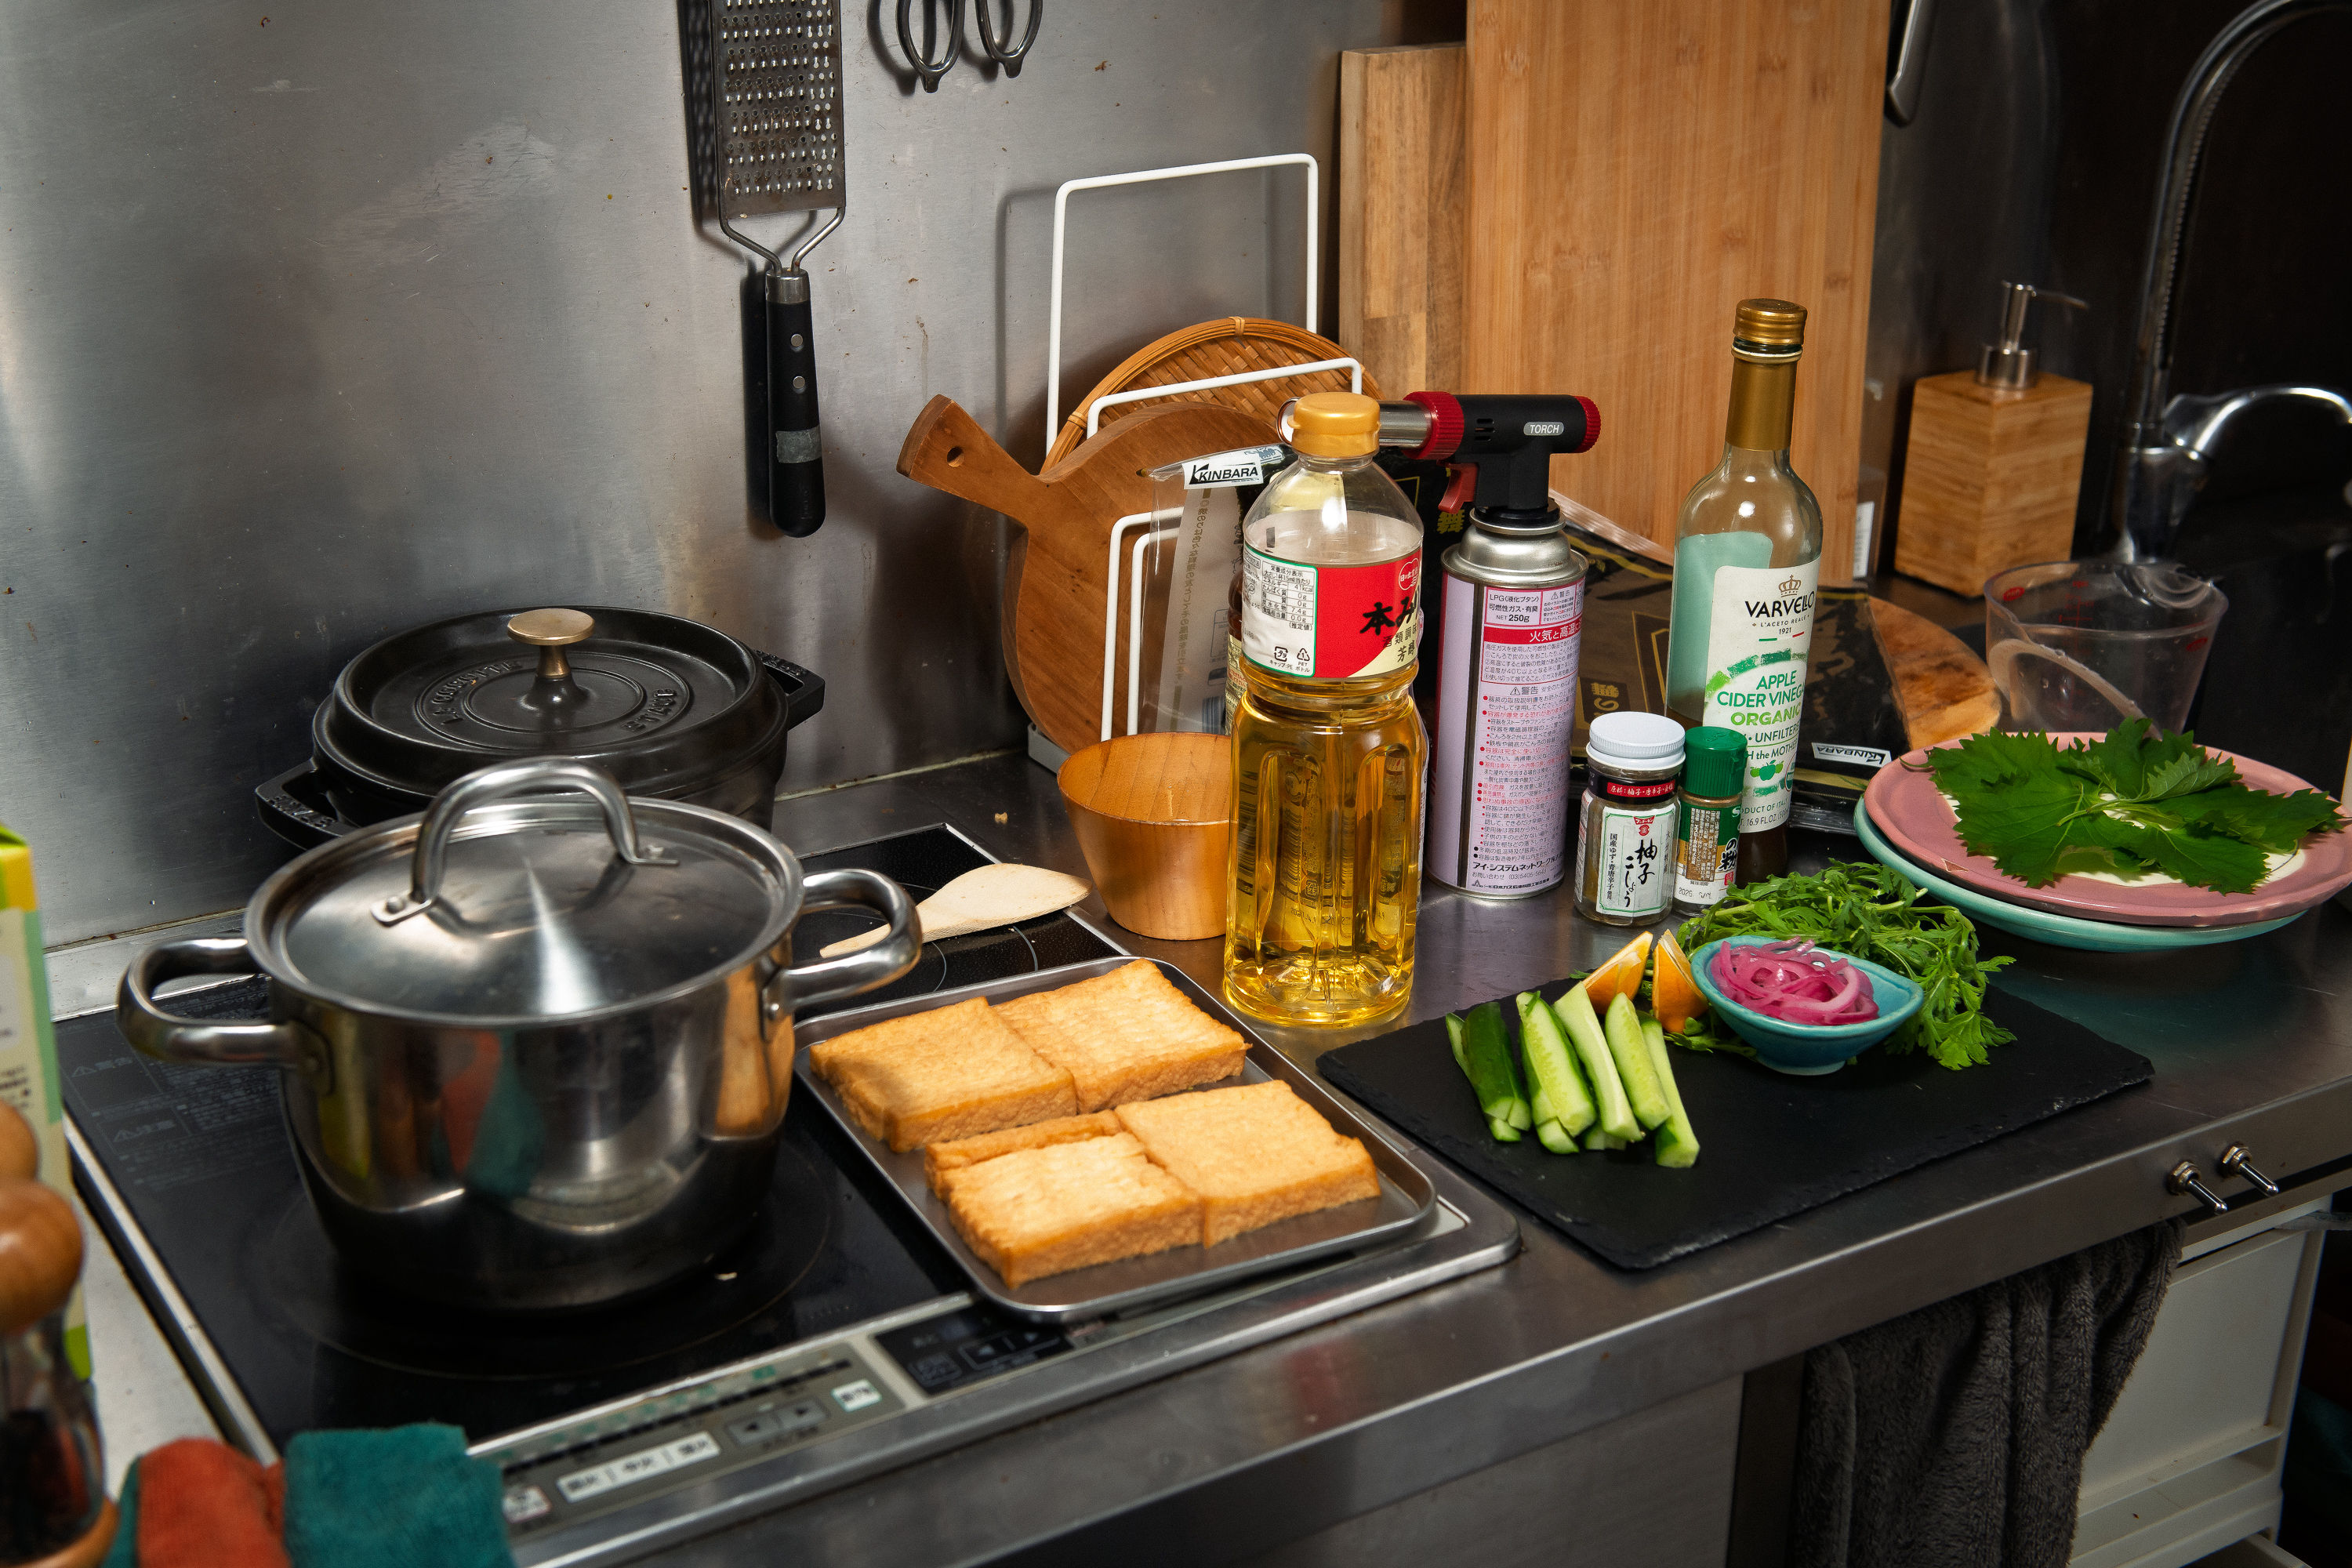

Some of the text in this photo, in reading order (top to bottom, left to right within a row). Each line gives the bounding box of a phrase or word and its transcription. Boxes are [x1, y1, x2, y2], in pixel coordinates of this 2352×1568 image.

[1530, 424, 1559, 434] TORCH
[1199, 466, 1258, 481] KINBARA
[1270, 565, 1303, 578] 栄養成分表示
[1262, 576, 1287, 589] エネルギー
[1744, 591, 1817, 619] VARVELLO
[1508, 614, 1530, 622] 250g
[1791, 615, 1806, 625] REALE
[1756, 670, 1796, 690] APPLE
[1717, 691, 1766, 708] CIDER
[1730, 706, 1802, 726] ORGANIC
[1756, 750, 1769, 759] the
[1816, 746, 1876, 760] KINBARA
[1742, 805, 1765, 814] DUCT
[1767, 803, 1775, 811] OF
[1747, 817, 1759, 826] 16.9
[1635, 838, 1657, 885] 柚子
[1624, 855, 1636, 908] こしょう
